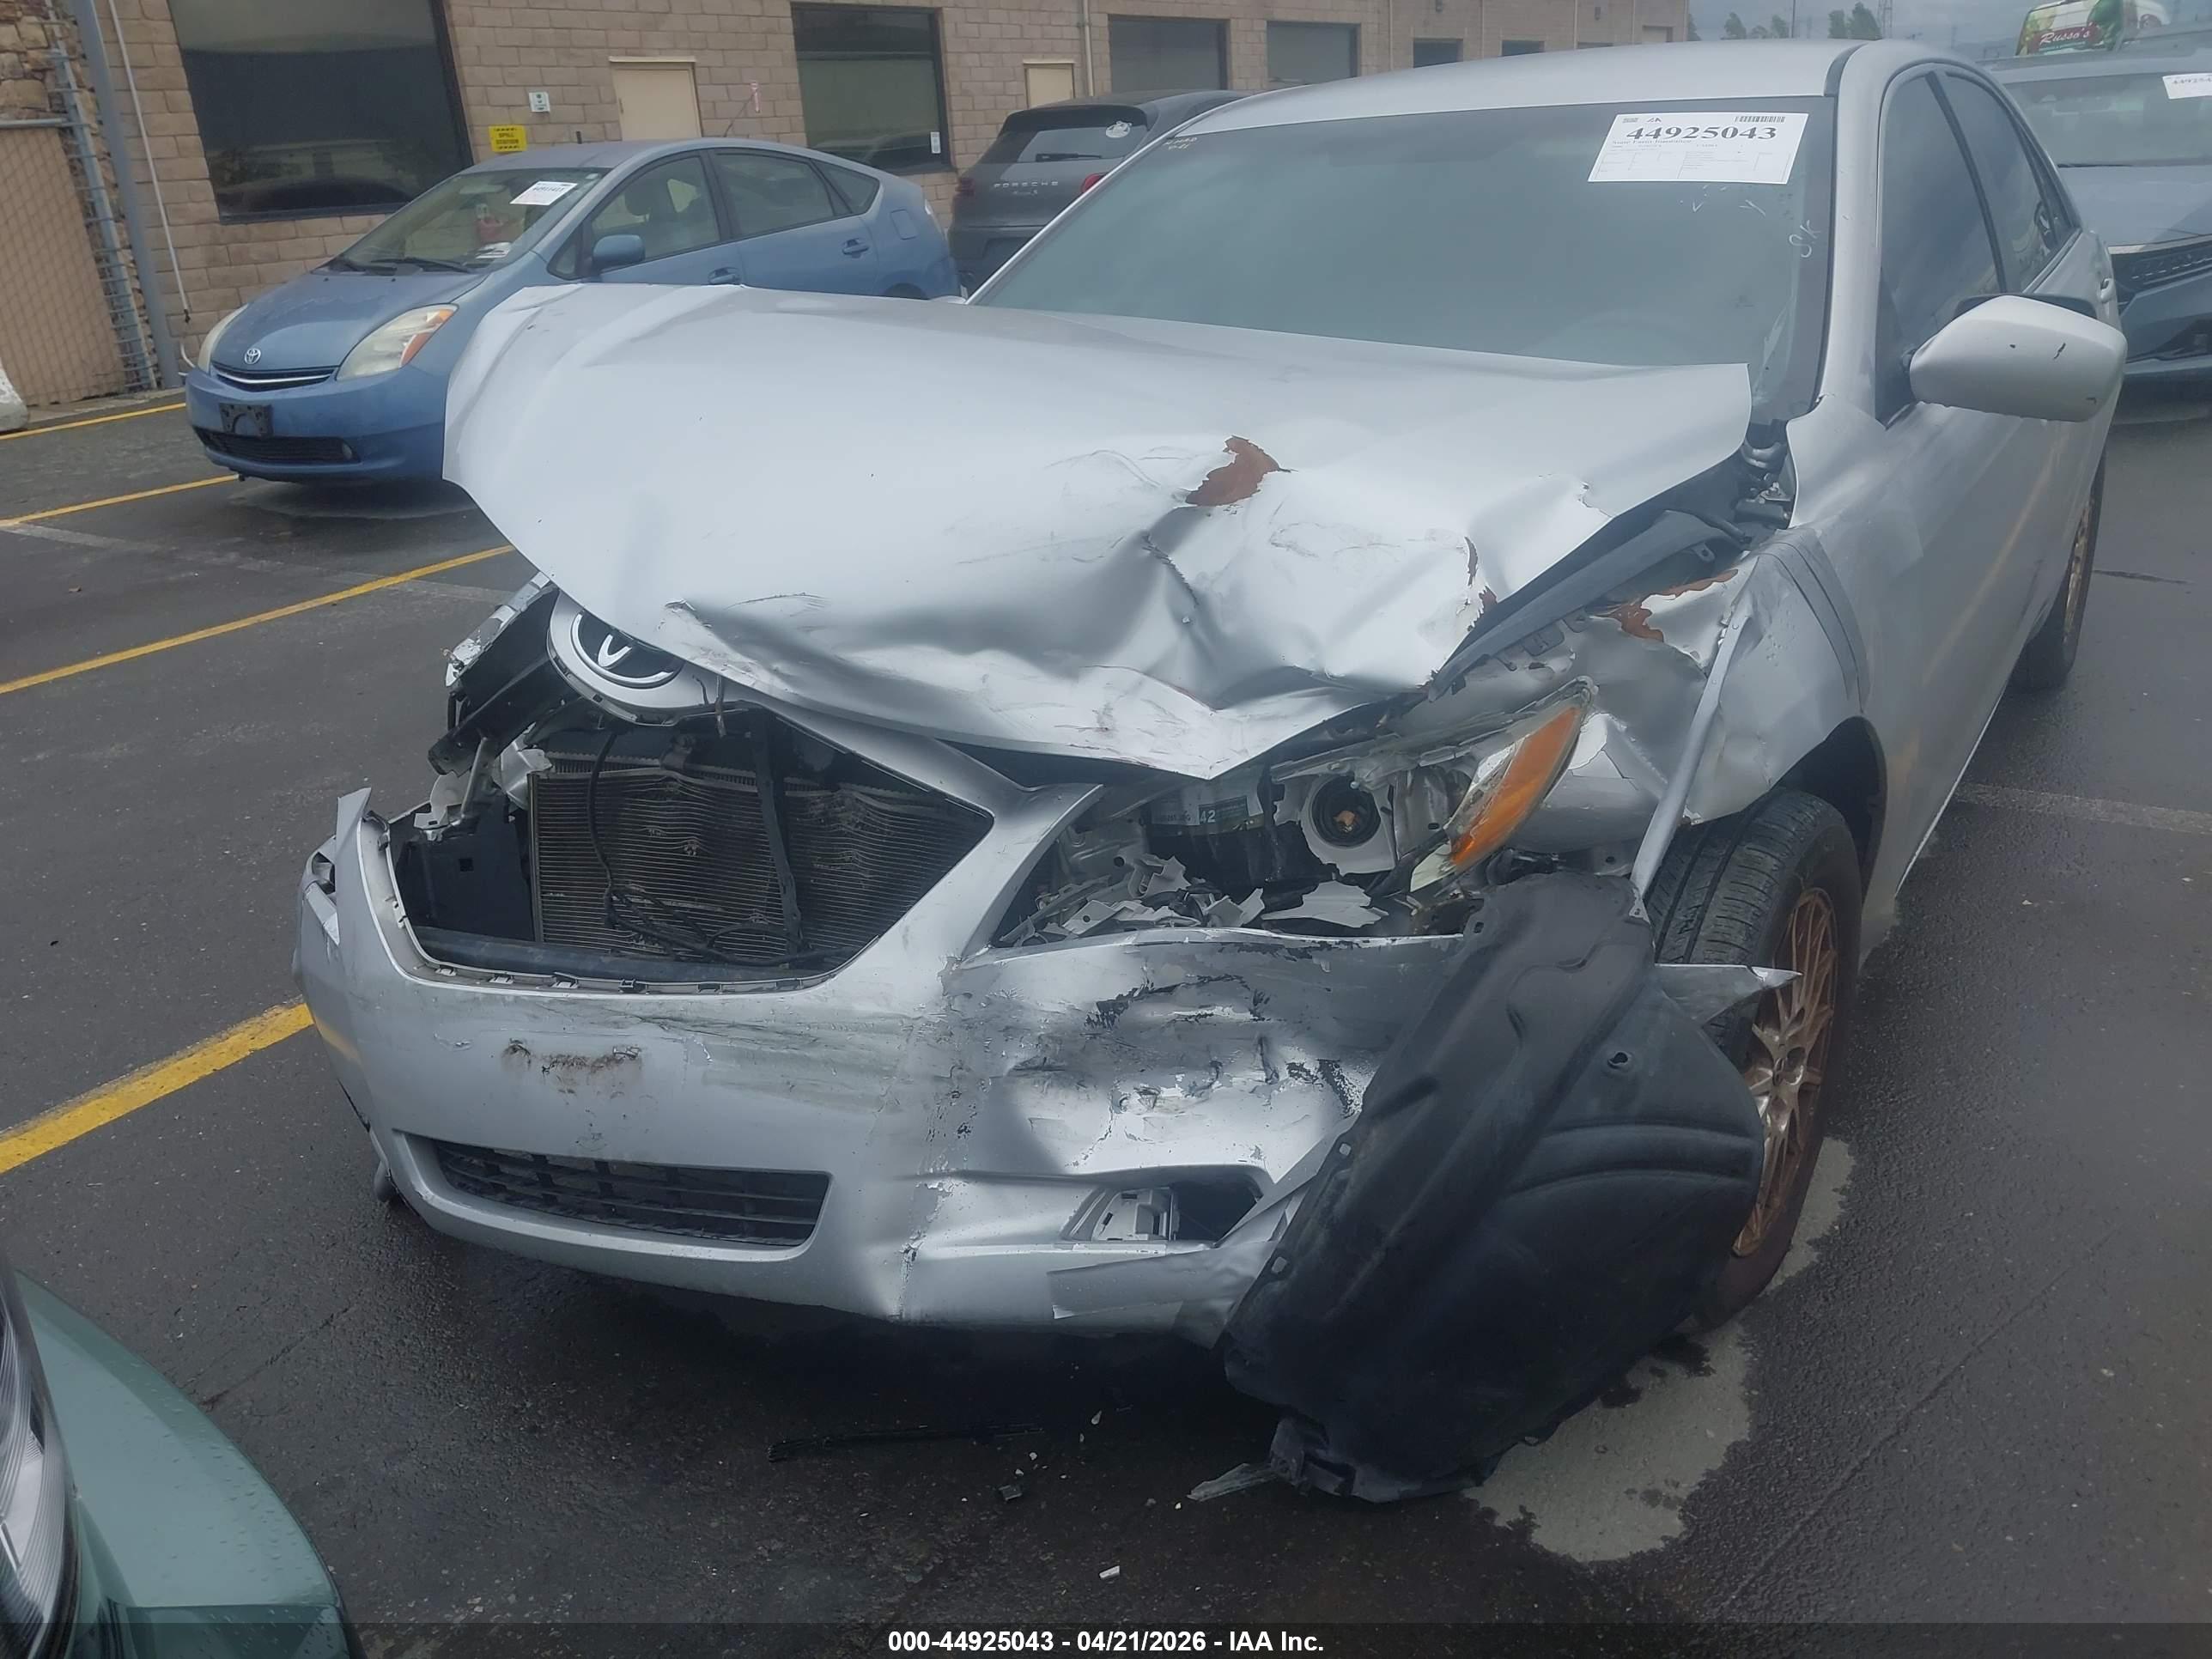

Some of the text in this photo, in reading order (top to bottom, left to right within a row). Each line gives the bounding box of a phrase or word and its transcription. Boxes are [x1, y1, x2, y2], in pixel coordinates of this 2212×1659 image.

[2039, 27, 2091, 46] Russo's
[1626, 126, 1778, 140] 44925043
[1200, 810, 1216, 823] 42
